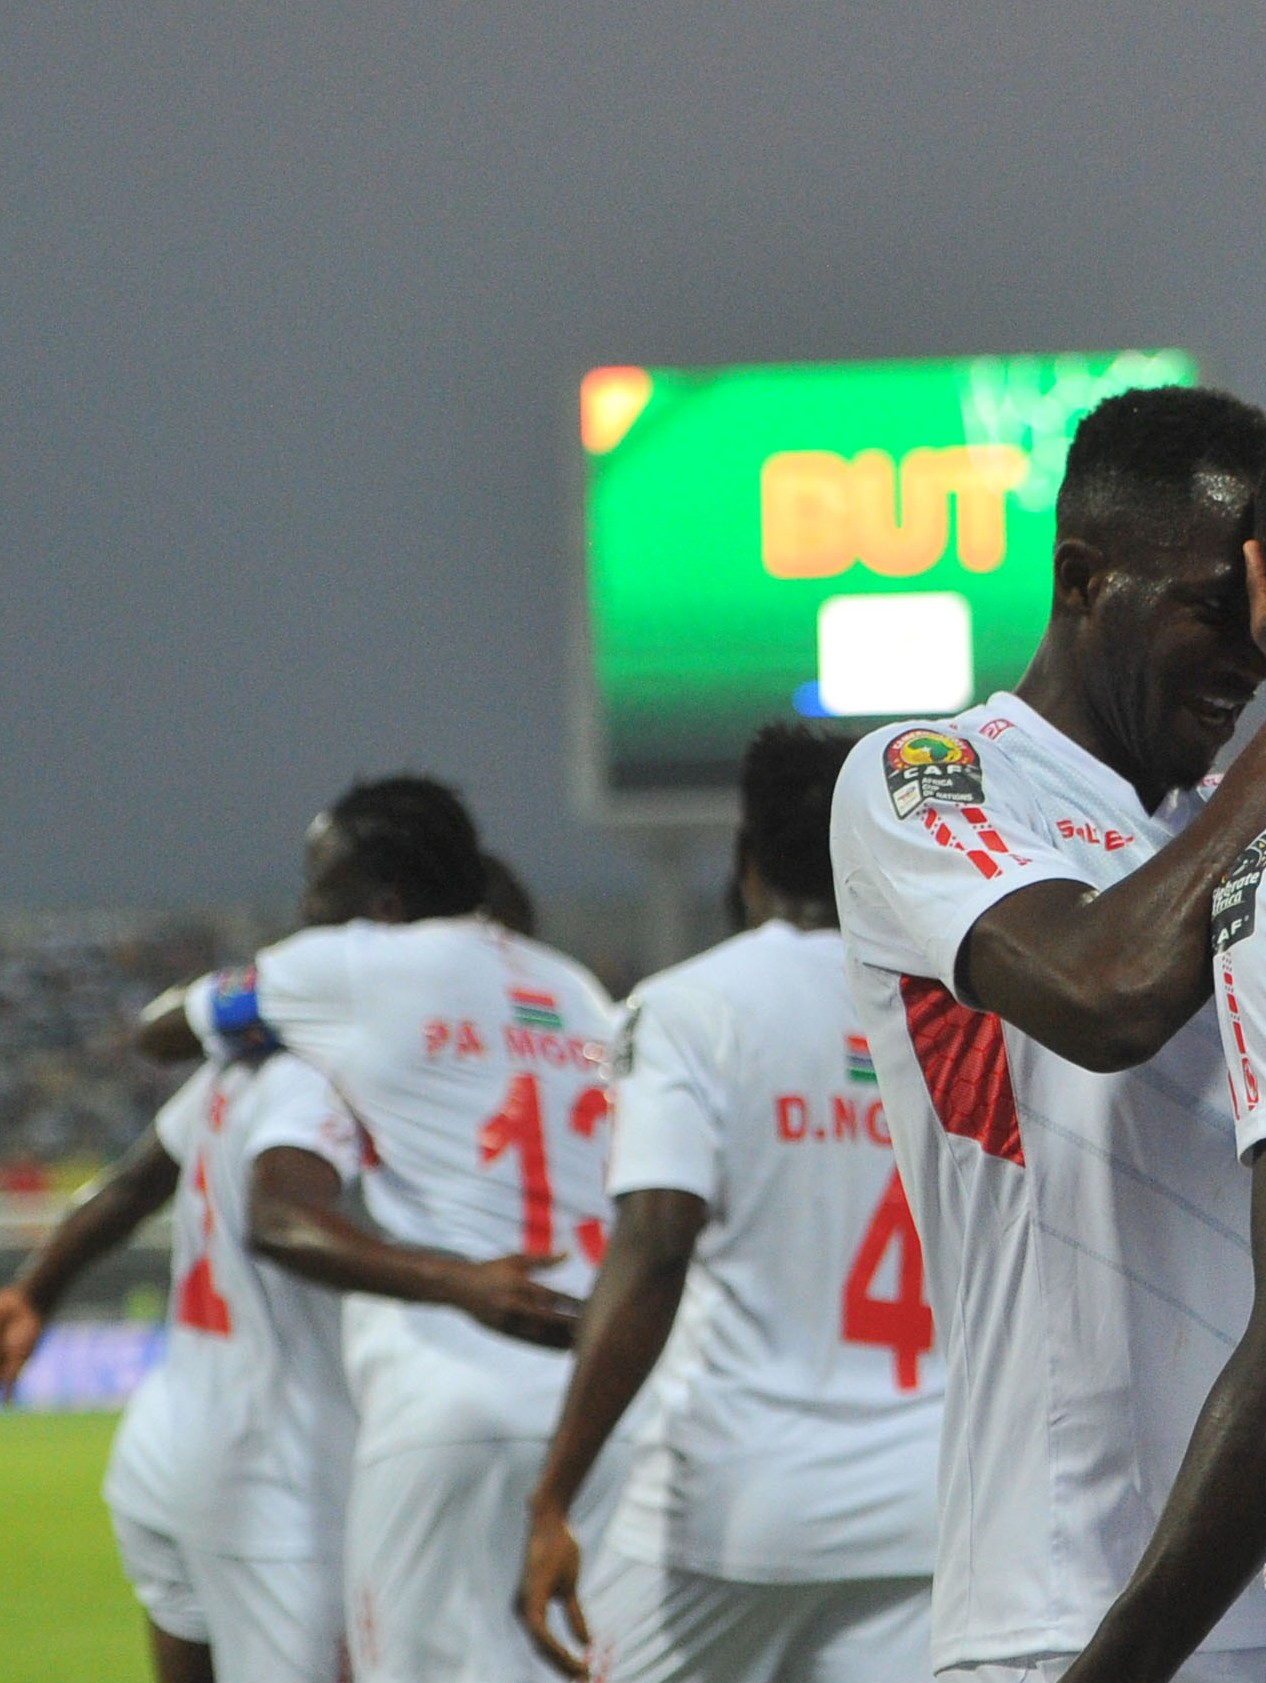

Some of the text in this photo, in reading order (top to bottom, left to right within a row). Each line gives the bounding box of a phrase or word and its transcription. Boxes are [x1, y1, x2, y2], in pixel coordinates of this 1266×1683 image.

[760, 443, 1028, 579] BUT
[903, 764, 961, 779] CAF
[423, 1021, 483, 1059] PA
[842, 1164, 934, 1390] 4
